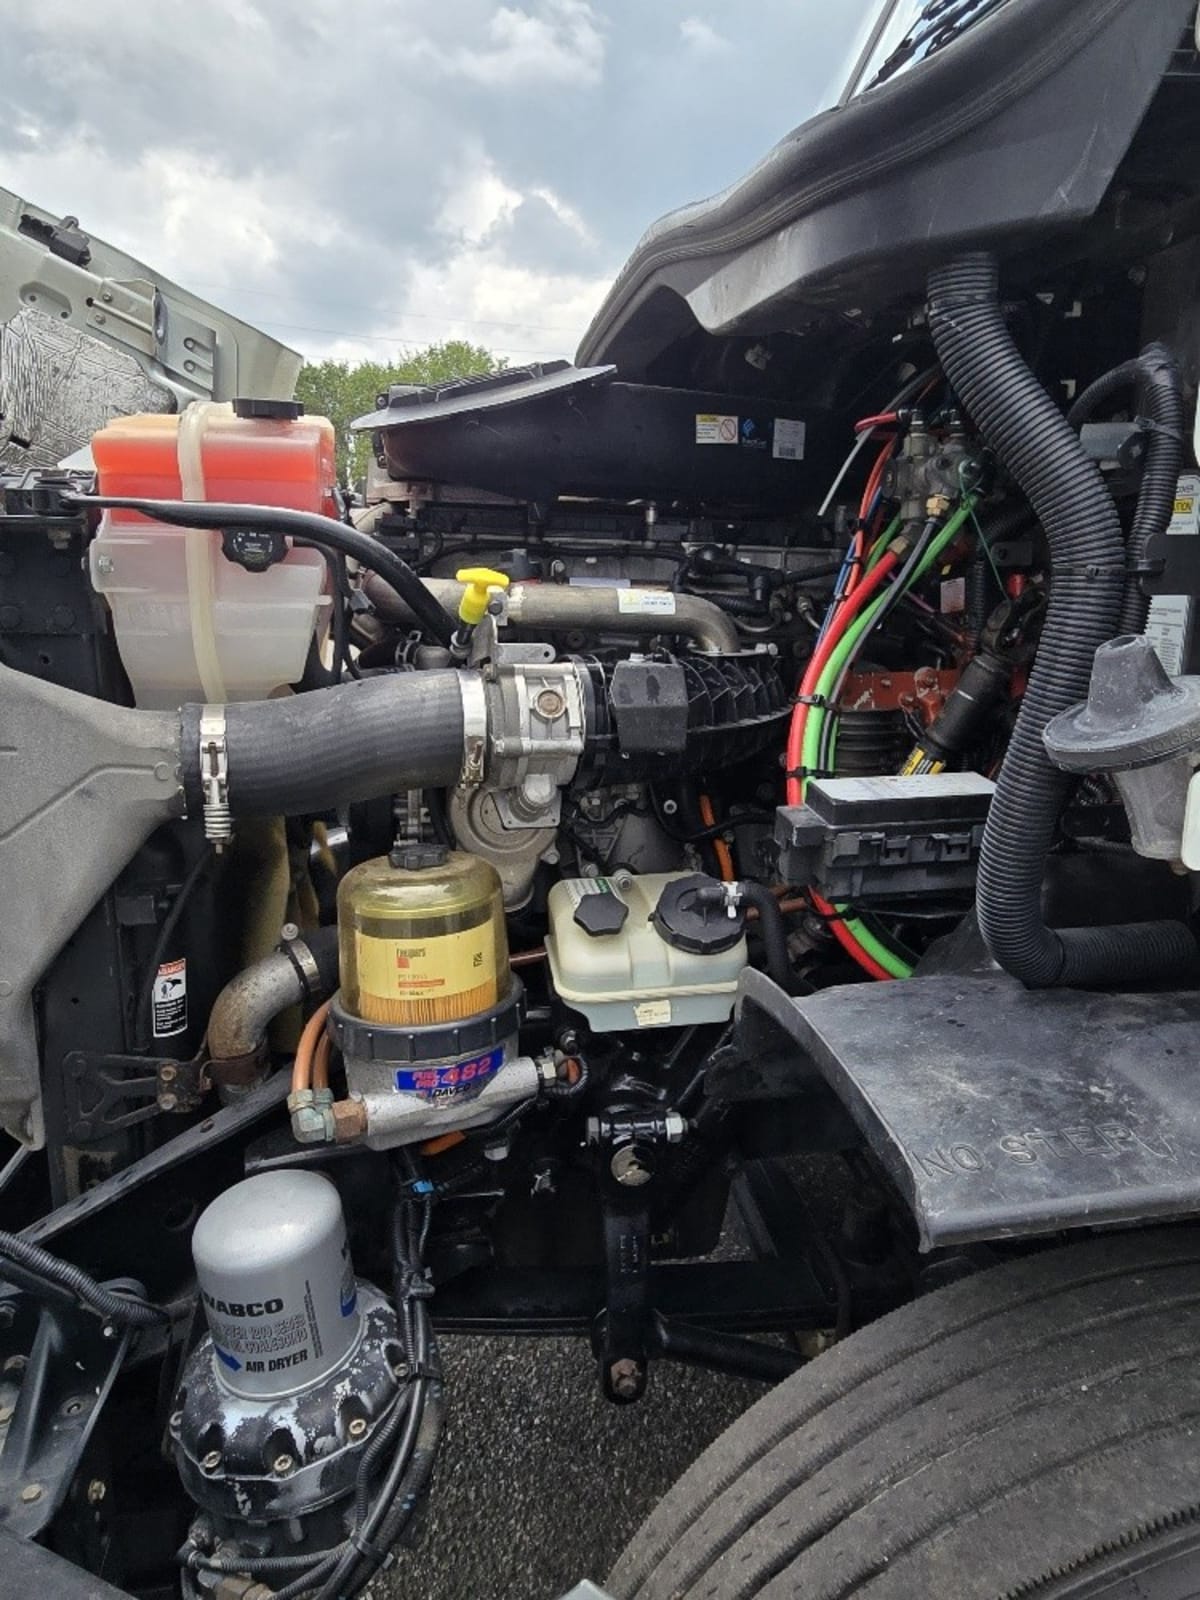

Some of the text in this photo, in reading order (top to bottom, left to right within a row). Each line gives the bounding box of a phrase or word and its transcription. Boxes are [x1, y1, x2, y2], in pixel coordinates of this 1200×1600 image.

[441, 1057, 492, 1085] 482
[432, 1083, 472, 1098] DAVCO
[911, 1123, 1132, 1177] NO STEP
[246, 1349, 308, 1373] AIR DRYER
